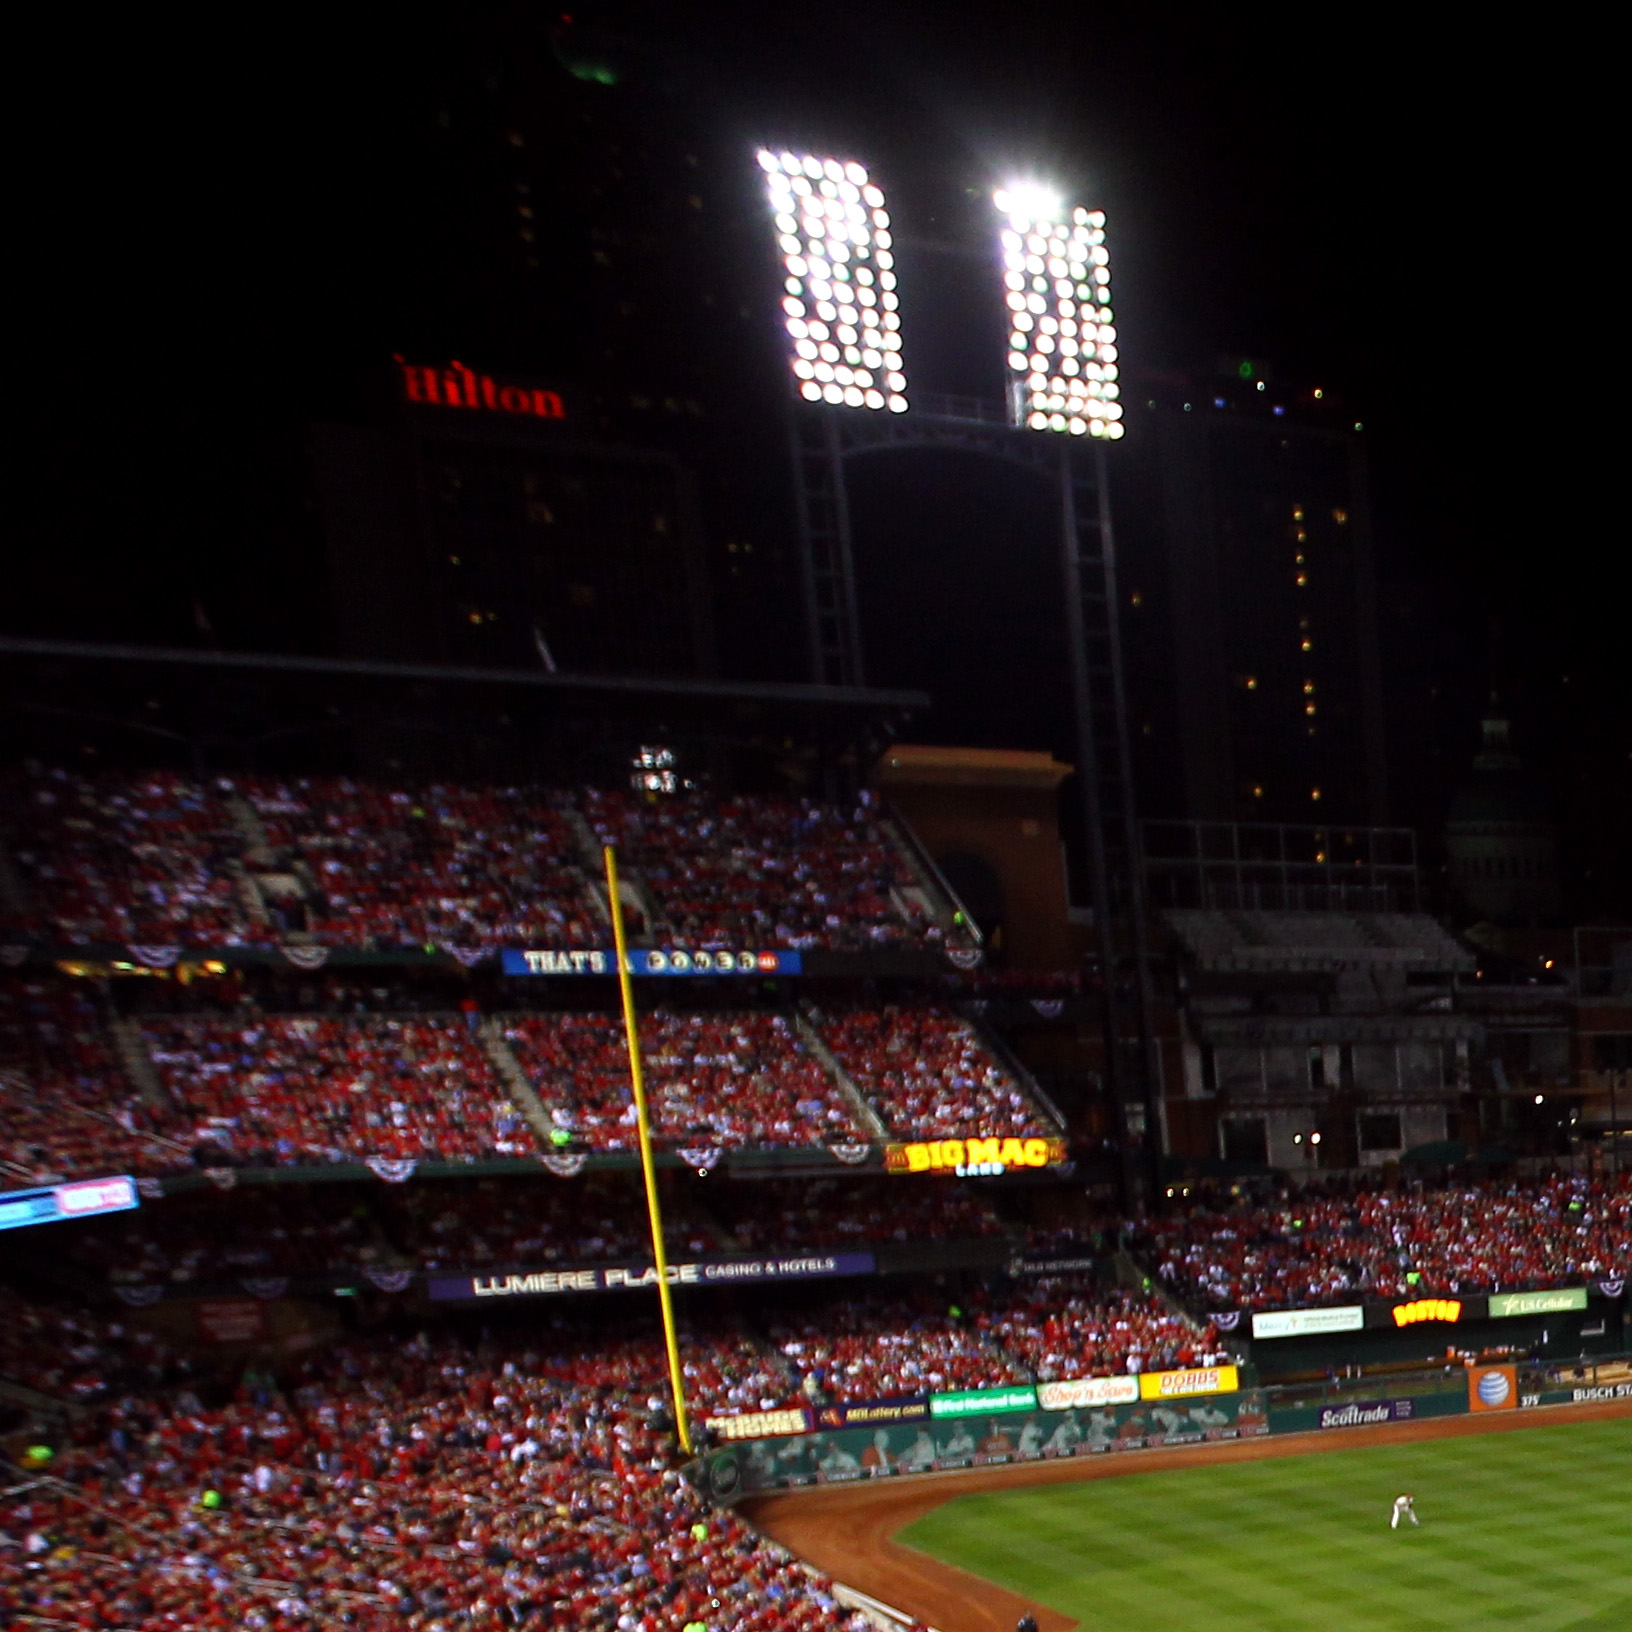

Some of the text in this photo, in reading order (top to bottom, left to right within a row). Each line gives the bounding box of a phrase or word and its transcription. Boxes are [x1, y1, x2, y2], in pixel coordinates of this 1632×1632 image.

[394, 352, 567, 420] Hilton
[523, 951, 607, 973] THAT'S
[905, 1137, 1048, 1172] BIG MAC
[956, 1162, 1003, 1176] LAND
[605, 1264, 700, 1288] PLACE
[705, 1262, 761, 1279] CASINO
[764, 1260, 775, 1275] &
[778, 1257, 836, 1274] HOTELS
[1393, 1299, 1460, 1327] BOSTON
[1161, 1369, 1219, 1388] DOBBS
[1573, 1387, 1613, 1402] BUSCH
